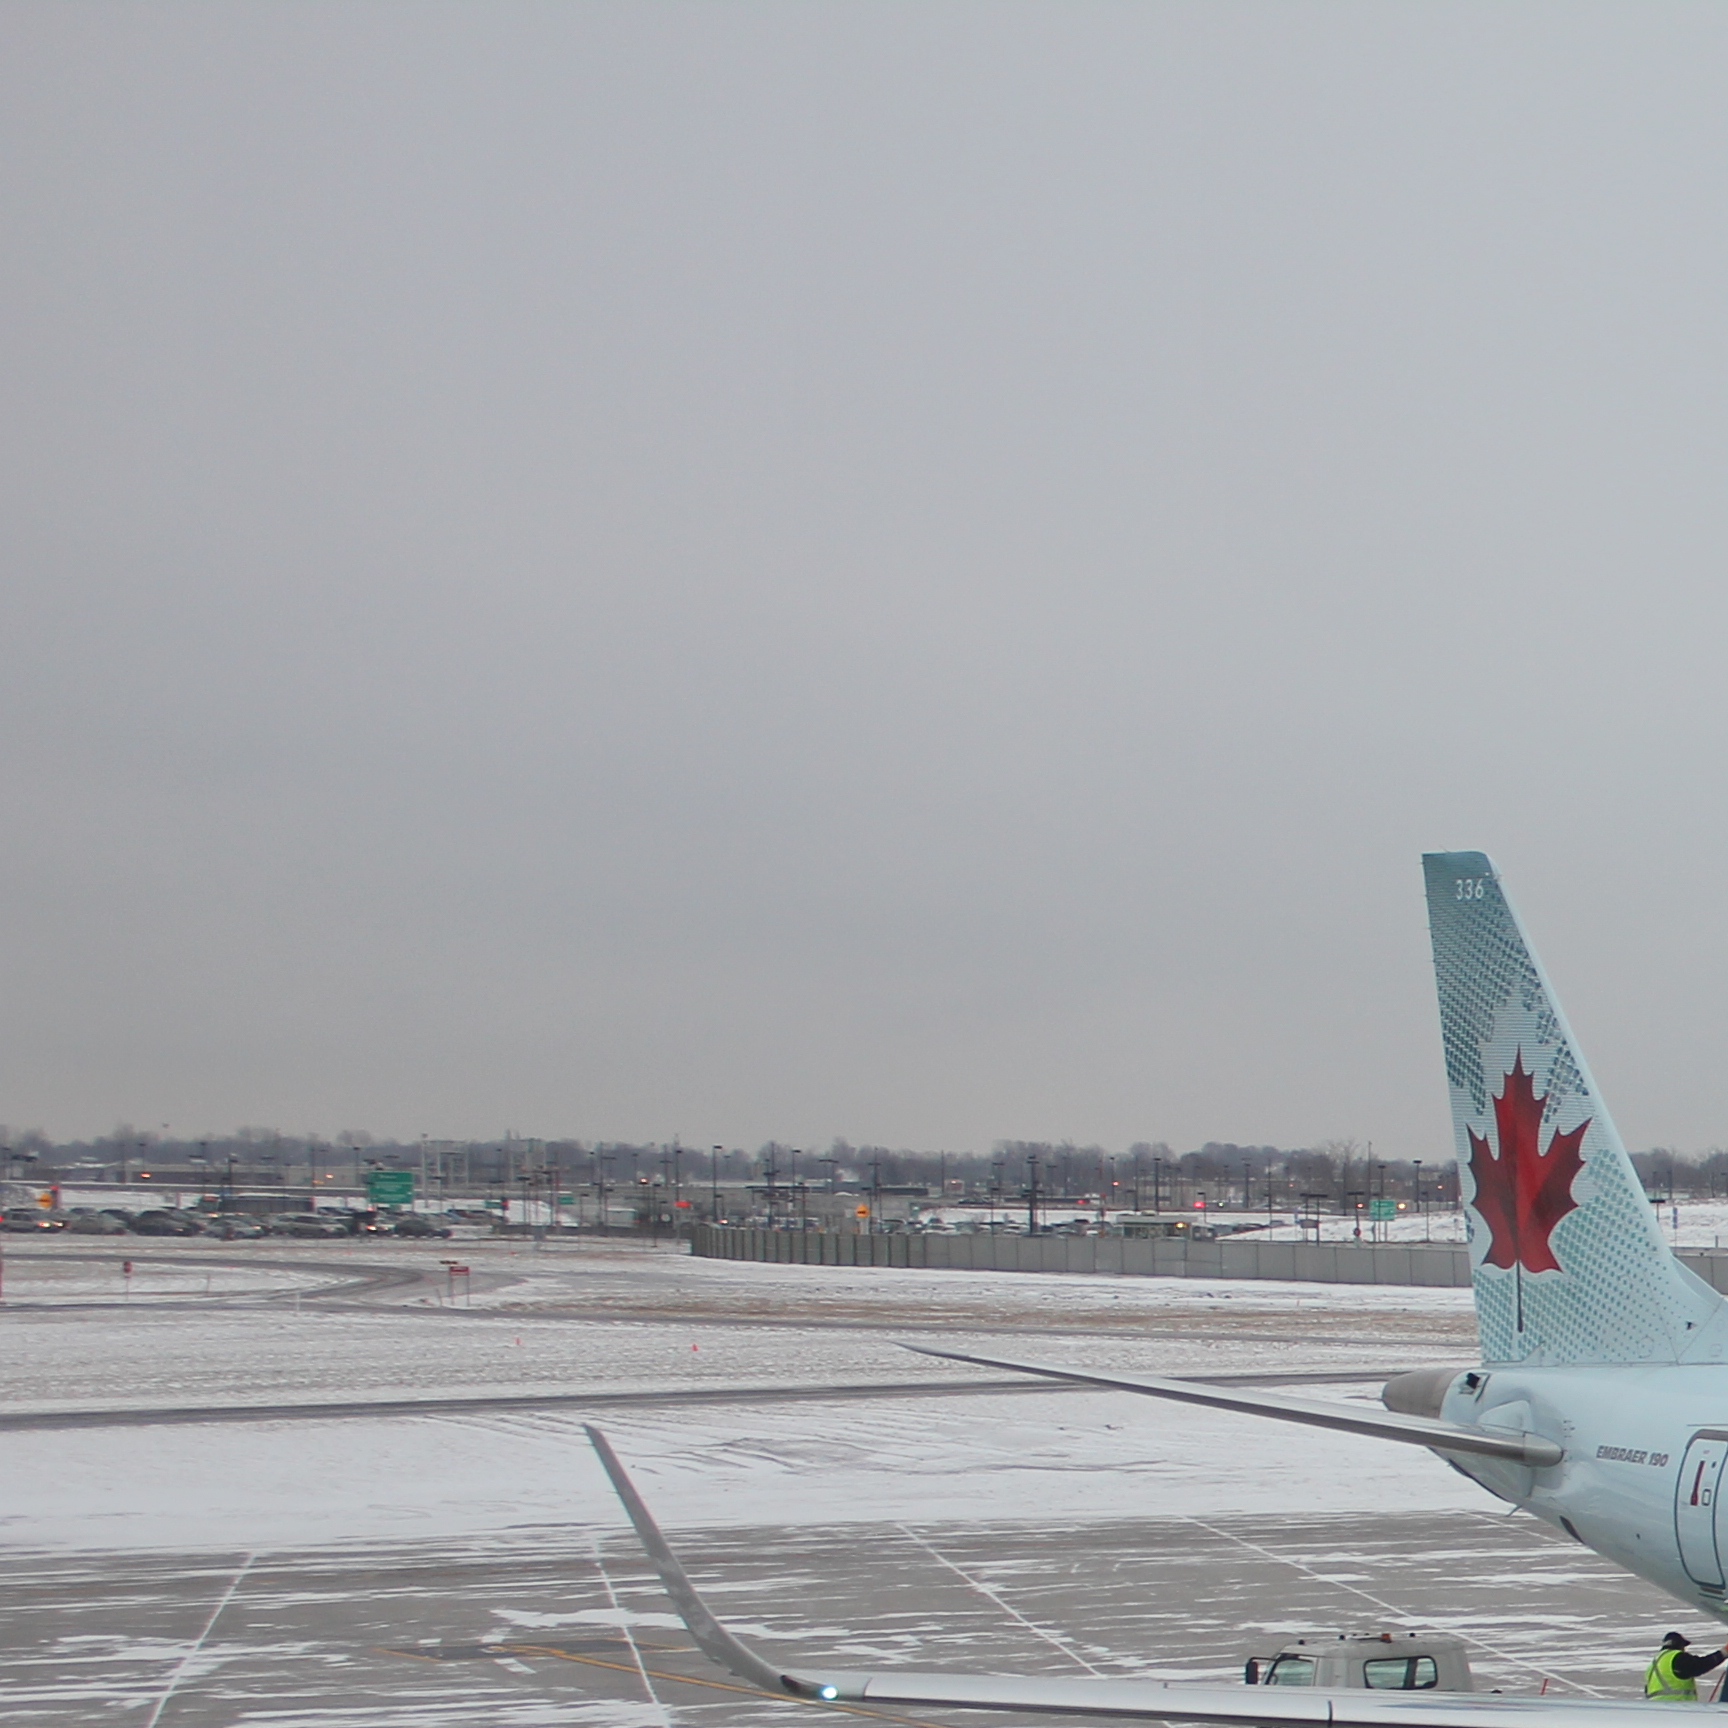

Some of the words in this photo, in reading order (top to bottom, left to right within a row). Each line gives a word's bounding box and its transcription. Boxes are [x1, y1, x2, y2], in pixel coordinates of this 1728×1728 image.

[1456, 878, 1484, 900] 336
[1596, 1445, 1648, 1465] EMBRAER
[1648, 1452, 1669, 1467] 190
